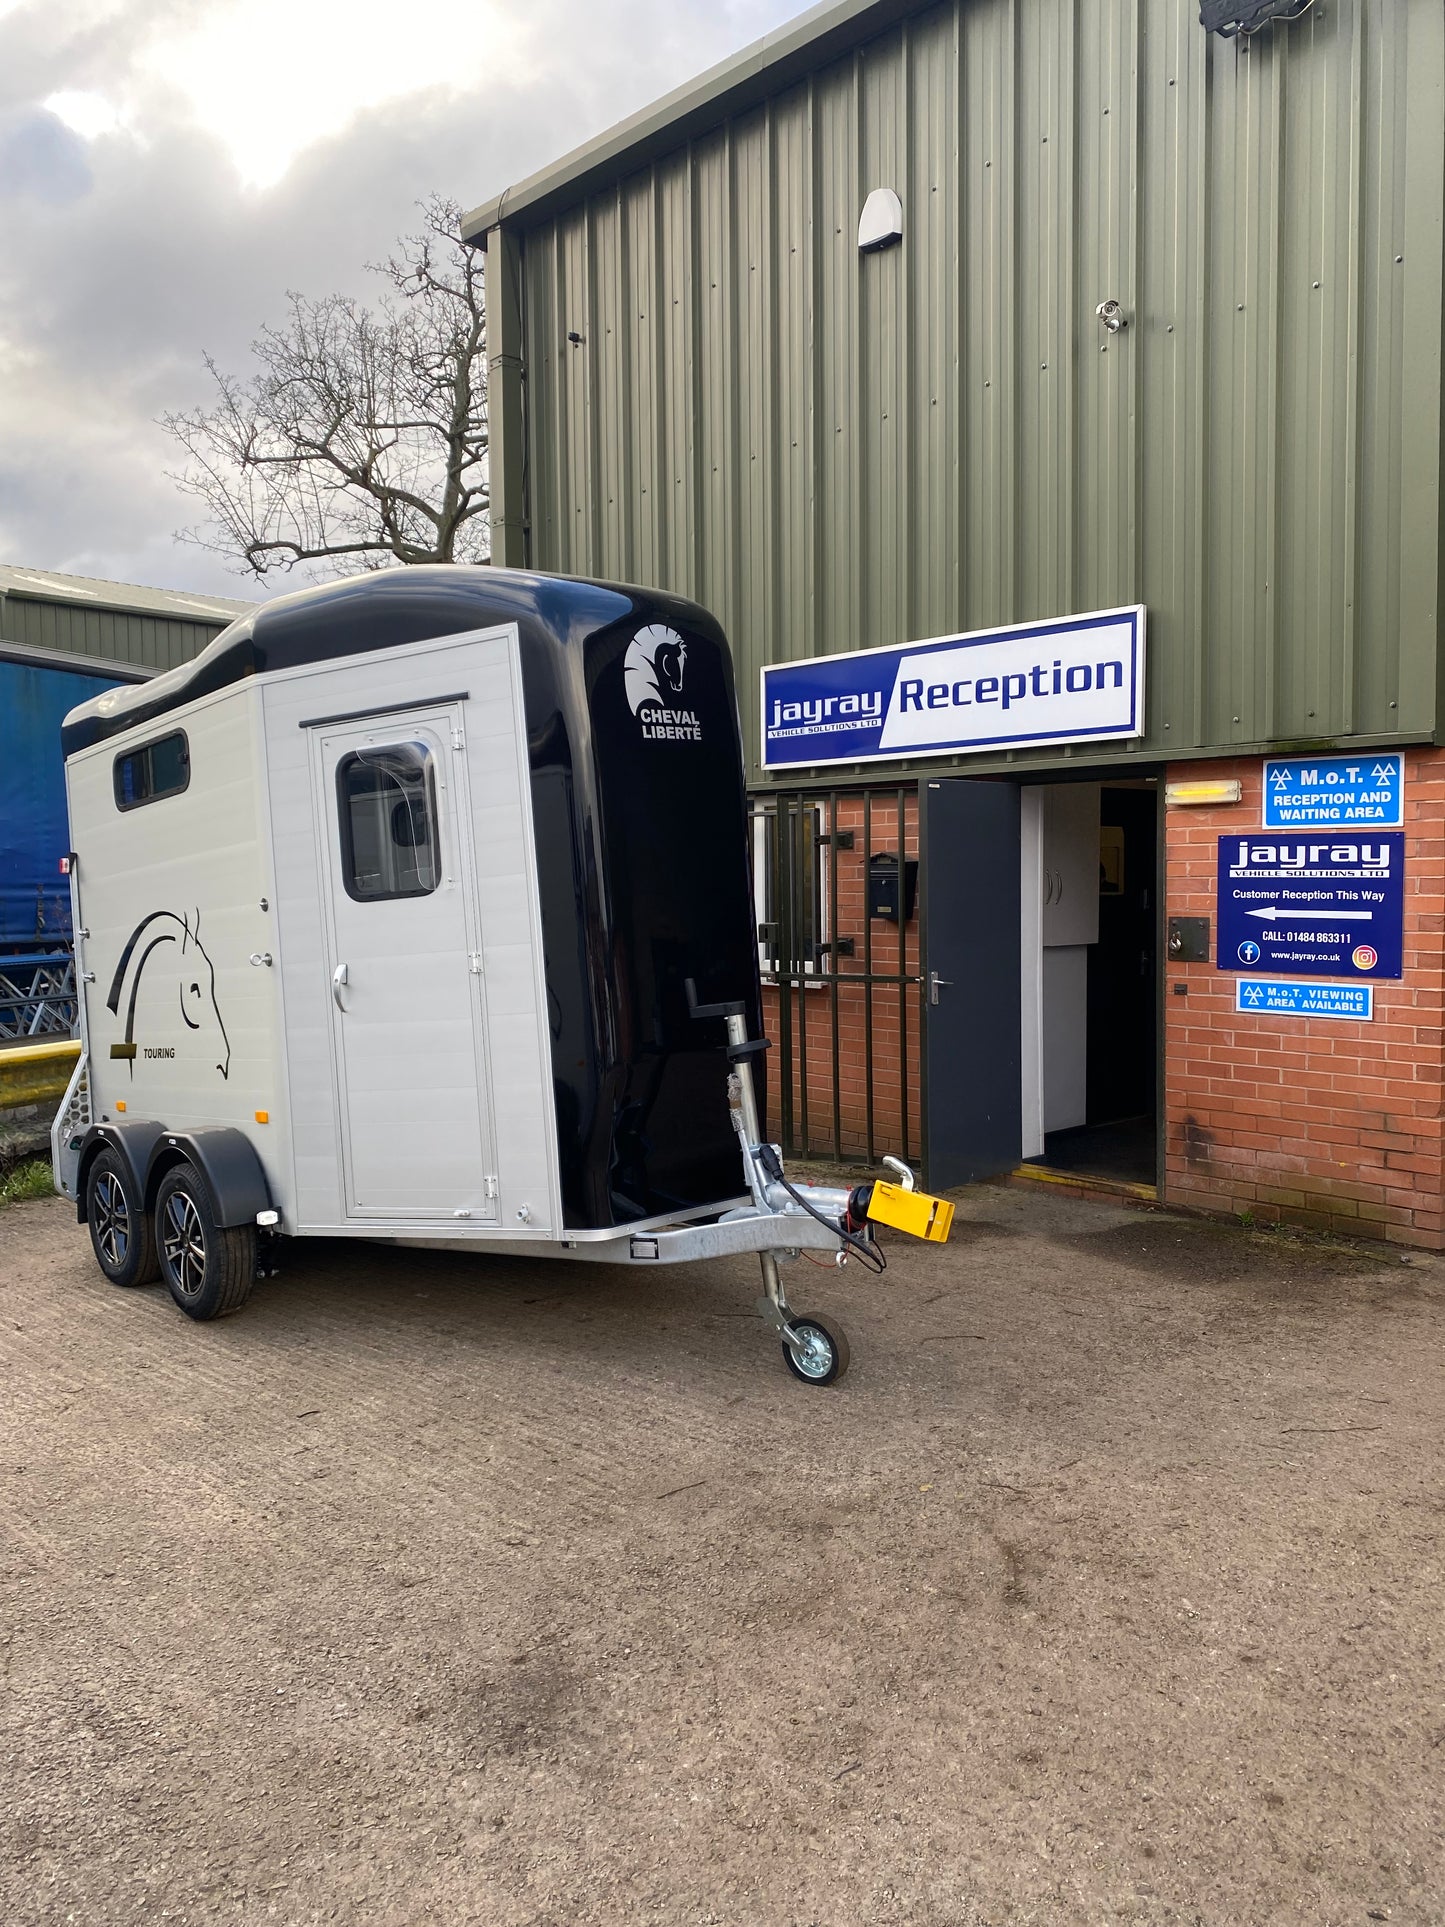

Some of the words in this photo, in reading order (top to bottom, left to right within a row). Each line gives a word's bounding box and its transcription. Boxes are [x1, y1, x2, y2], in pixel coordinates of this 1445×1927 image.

[900, 659, 1123, 713] Reception
[640, 708, 700, 725] CHEVAL
[768, 691, 882, 729] jayray
[642, 724, 702, 741] LIBERTÉ
[771, 727, 804, 738] VEHICLE
[808, 721, 858, 734] SOLUTIONS
[860, 719, 878, 728] LTD
[1300, 767, 1364, 786] M.o.T.
[1273, 792, 1355, 807] RECEPTION
[1359, 791, 1392, 804] AND
[1279, 807, 1340, 820] WAITING
[1344, 806, 1385, 819] AREA
[1230, 841, 1390, 869] jayray
[1232, 889, 1280, 899] Customer
[1282, 890, 1334, 902] Reception
[1336, 890, 1359, 900] This
[1361, 890, 1385, 902] Way
[1262, 931, 1286, 942] CALL:
[1286, 931, 1315, 943] 01484
[1316, 932, 1351, 944] 863311
[1271, 951, 1341, 962] www.jayray.co.uk
[1267, 987, 1303, 998] M.o.T.
[1309, 989, 1364, 1001] VIEWING
[1266, 998, 1296, 1008] AREA
[1301, 1000, 1364, 1012] AVAILABLE
[143, 1048, 175, 1059] TOURING
